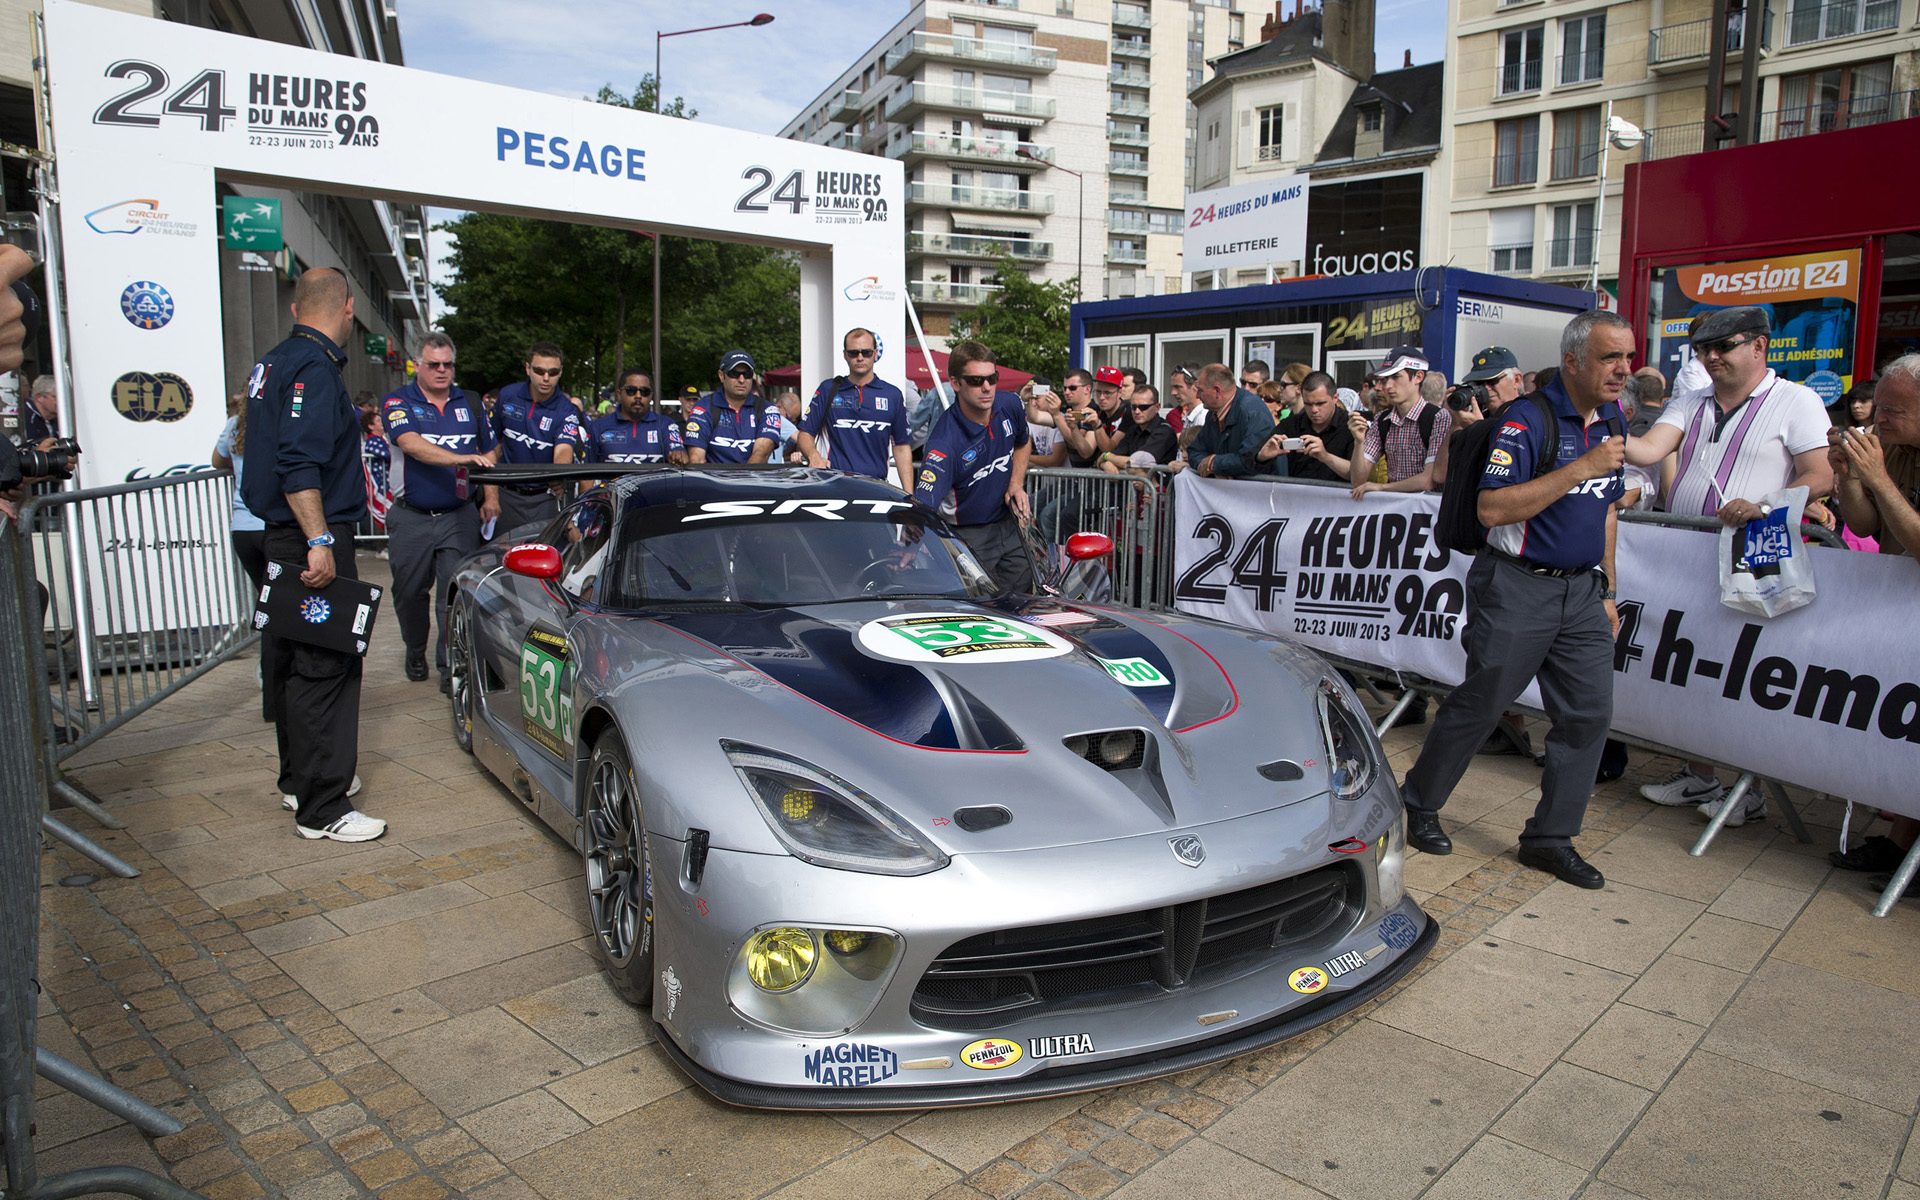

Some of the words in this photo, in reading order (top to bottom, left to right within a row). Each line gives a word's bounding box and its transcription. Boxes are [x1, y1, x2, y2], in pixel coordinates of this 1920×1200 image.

[92, 58, 236, 132] 24
[250, 72, 366, 112] HEURES
[248, 108, 273, 124] DU
[280, 110, 328, 128] MANS
[249, 136, 280, 147] 22-23
[283, 138, 306, 148] JUIN
[309, 139, 334, 149] 2013
[352, 134, 378, 147] ANS
[496, 126, 646, 181] PESAGE
[734, 164, 810, 214] 24
[816, 171, 881, 196] HEURES
[816, 196, 829, 208] DU
[833, 196, 860, 208] MANS
[1189, 204, 1216, 228] 24
[1218, 199, 1252, 220] HEURES
[1254, 194, 1268, 210] DU
[1272, 184, 1302, 204] MANS
[128, 210, 169, 220] CIRCUIT
[156, 220, 198, 230] HEURES
[816, 216, 832, 224] 22-23
[872, 212, 887, 222] ANS
[146, 226, 162, 234] DU
[164, 228, 196, 238] MANS
[1205, 237, 1278, 256] BILLETTERIE
[1697, 264, 1800, 295] Passion
[1809, 264, 1841, 286] 24
[1372, 300, 1416, 324] HEURES
[1324, 312, 1368, 348] 24
[1372, 322, 1380, 332] DU
[1382, 319, 1400, 330] MANS
[1786, 348, 1843, 361] ADHÉSION
[833, 419, 891, 434] SRT
[420, 434, 476, 449] SRT
[503, 428, 553, 450] SRT
[710, 437, 755, 452] SR
[605, 454, 663, 464] SRT
[680, 500, 914, 522] SRT
[1176, 513, 1290, 612] 24
[1296, 572, 1325, 600] DU
[1330, 574, 1392, 603] MANS
[901, 622, 1028, 646] 53
[1294, 618, 1326, 636] 22-23
[1329, 620, 1358, 638] JUIN
[1360, 623, 1390, 642] 2013
[1412, 612, 1458, 640] ANS
[942, 645, 970, 656] 24
[1104, 658, 1160, 681] PRO
[522, 648, 556, 730] 53
[1322, 950, 1367, 978] ULTRA
[1296, 970, 1321, 990] PENNZOIL
[804, 1043, 898, 1071] MAGNETI
[970, 1044, 1014, 1062] PENNZOIL
[1027, 1033, 1096, 1060] ULTRA
[804, 1060, 898, 1088] MARELLI
